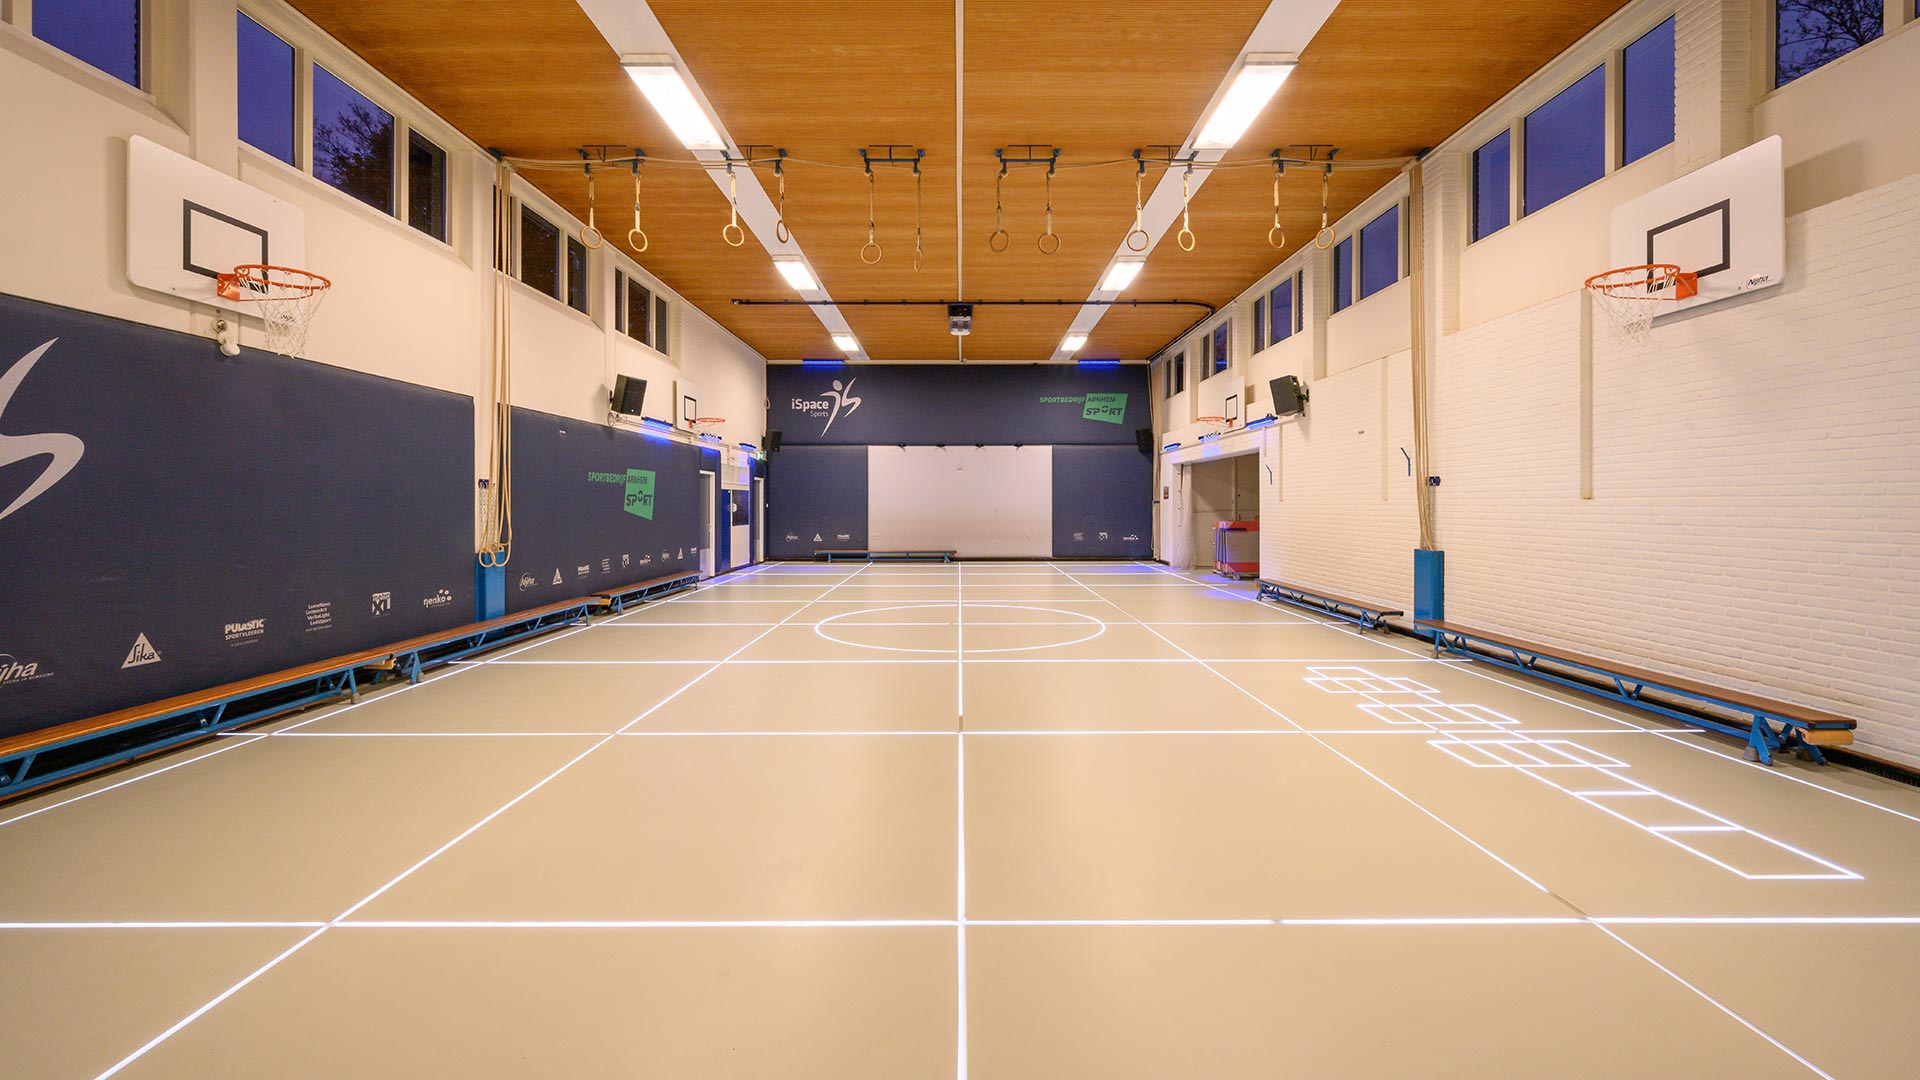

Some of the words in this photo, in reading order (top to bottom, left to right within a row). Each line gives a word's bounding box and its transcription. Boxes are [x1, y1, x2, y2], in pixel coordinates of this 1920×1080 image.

[791, 398, 829, 412] iSpace
[1039, 396, 1086, 404] SPORTBEDRIJF
[810, 410, 829, 418] Sports
[1086, 405, 1123, 416] SPORT
[587, 471, 627, 486] SPORTBEDRIJF
[627, 475, 648, 484] ARNHEM
[626, 490, 652, 506] SPORT
[225, 618, 264, 634] PULASTIC
[225, 629, 264, 641] SPORTVLOEREN
[128, 643, 155, 664] Sika
